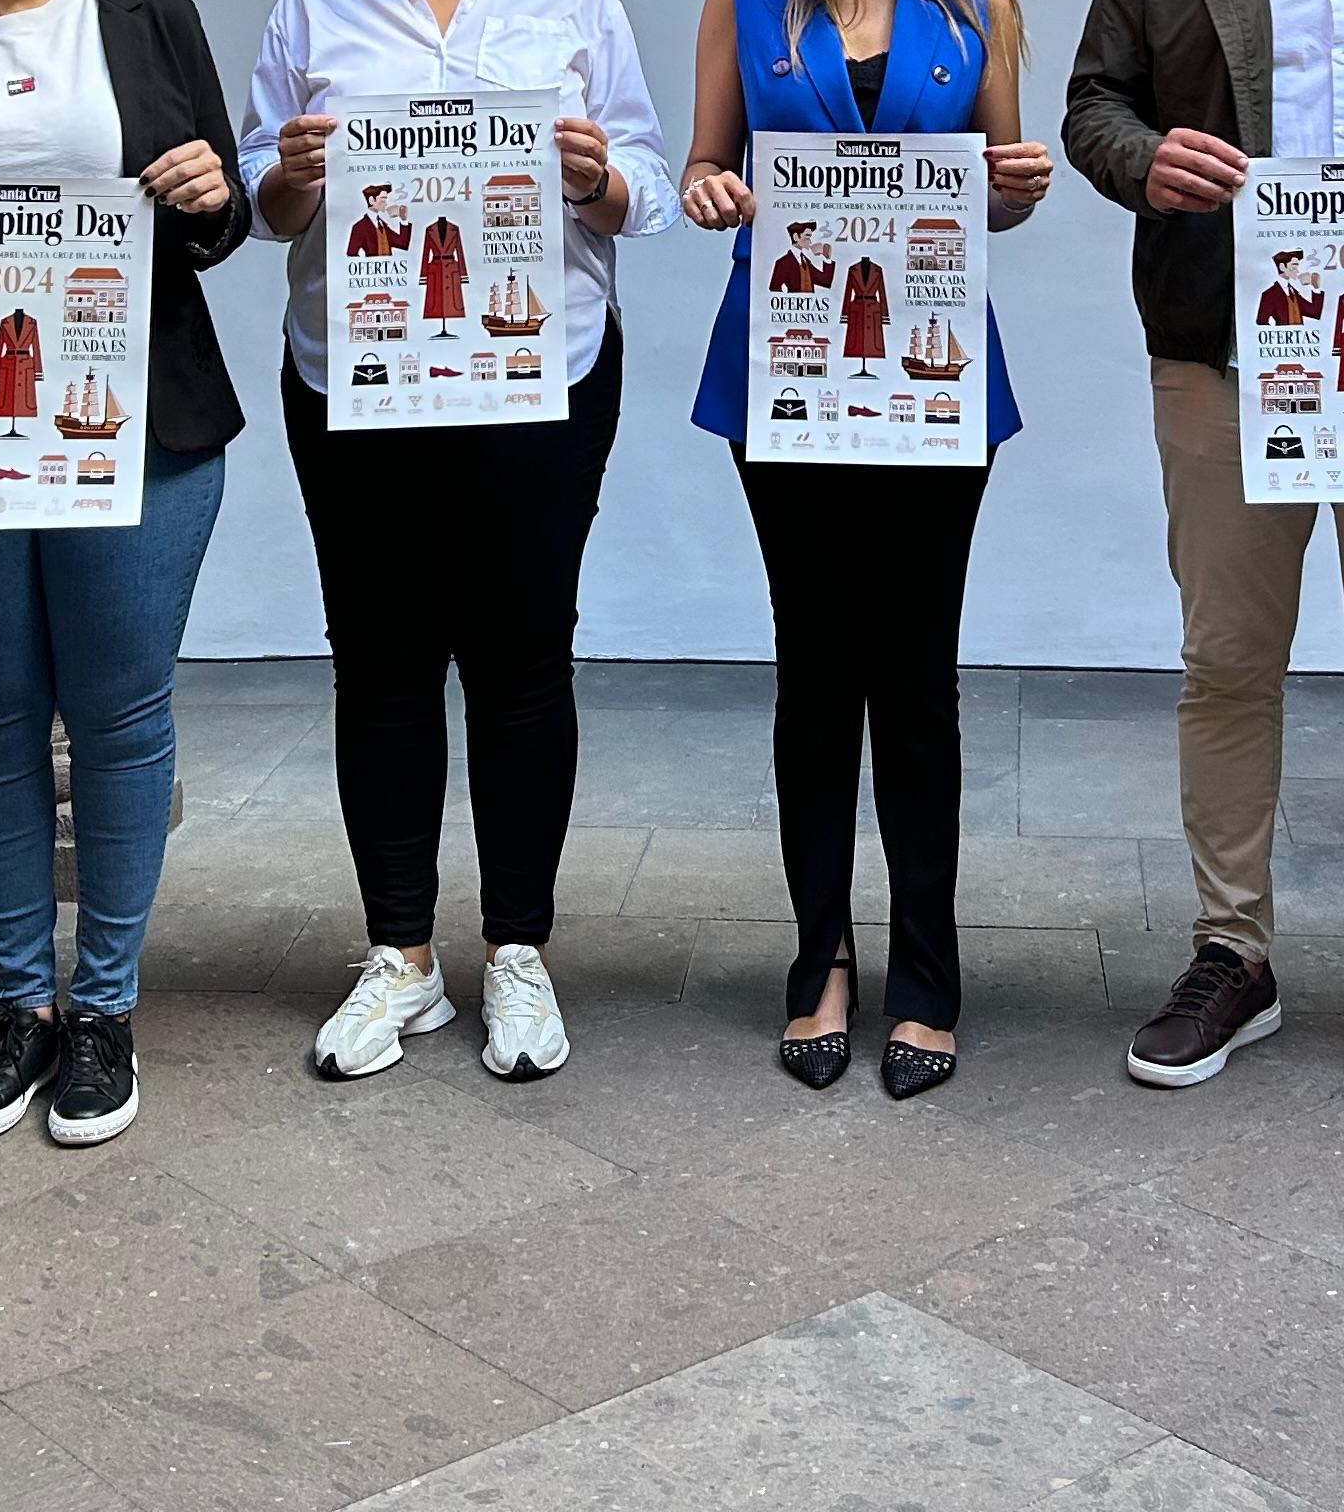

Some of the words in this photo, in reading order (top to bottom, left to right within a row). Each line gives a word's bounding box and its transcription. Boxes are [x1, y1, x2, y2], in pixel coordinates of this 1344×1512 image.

[411, 101, 443, 116] Santa
[444, 101, 471, 115] Cruz
[347, 118, 478, 159] Shopping
[487, 115, 543, 155] Day
[838, 141, 870, 155] Santa
[870, 142, 898, 156] Cruz
[774, 155, 904, 199] Shopping
[914, 158, 970, 199] Day
[28, 186, 58, 201] Cruz
[410, 175, 473, 203] 2024
[75, 203, 135, 247] Day
[834, 216, 897, 243] 2024
[482, 231, 514, 242] DONDE
[515, 230, 543, 241] CADA
[22, 251, 50, 259] SANTA
[483, 242, 526, 256] TIENDA
[528, 241, 543, 254] ES
[347, 259, 408, 276] OFERTAS
[348, 276, 407, 289] EXCLUSIVAS
[904, 274, 937, 285] DONDE
[939, 274, 966, 286] CADA
[905, 285, 949, 299] TIENDA
[951, 286, 966, 299] ES
[770, 296, 829, 312] OFERTAS
[770, 312, 829, 324] EXCLUSIVAS
[60, 326, 96, 338] DONDE
[97, 327, 127, 338] CADA
[1258, 329, 1321, 345] OFERTAS
[61, 338, 108, 353] TIENDA
[110, 339, 126, 353] ES
[1259, 346, 1320, 358] EXCLUSIVAS
